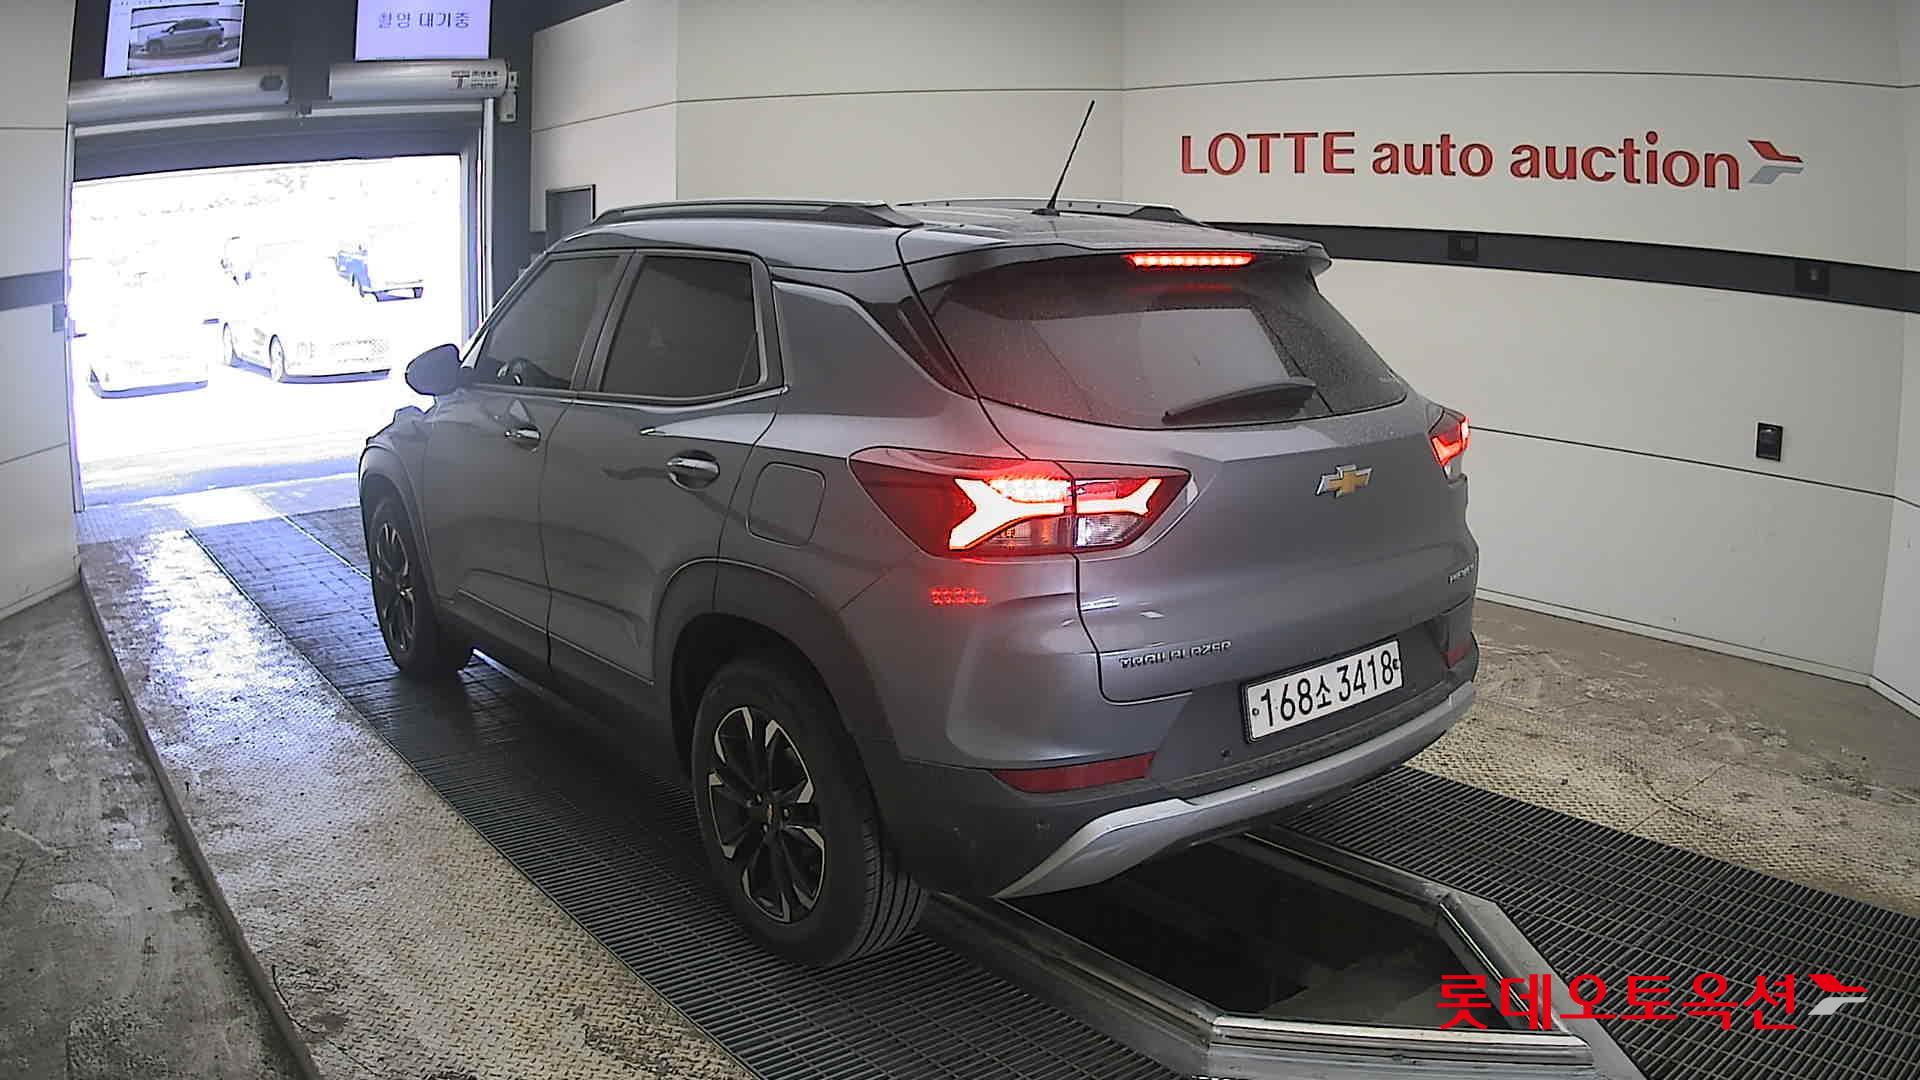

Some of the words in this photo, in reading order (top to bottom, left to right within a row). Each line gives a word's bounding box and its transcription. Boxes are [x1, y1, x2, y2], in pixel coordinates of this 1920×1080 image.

[419, 12, 470, 29] 대기중
[1181, 131, 1355, 177] LOTTE
[1372, 133, 1495, 178] auto
[1510, 131, 1741, 190] auction
[1260, 674, 1333, 727] 168소
[1336, 650, 1394, 702] 3418
